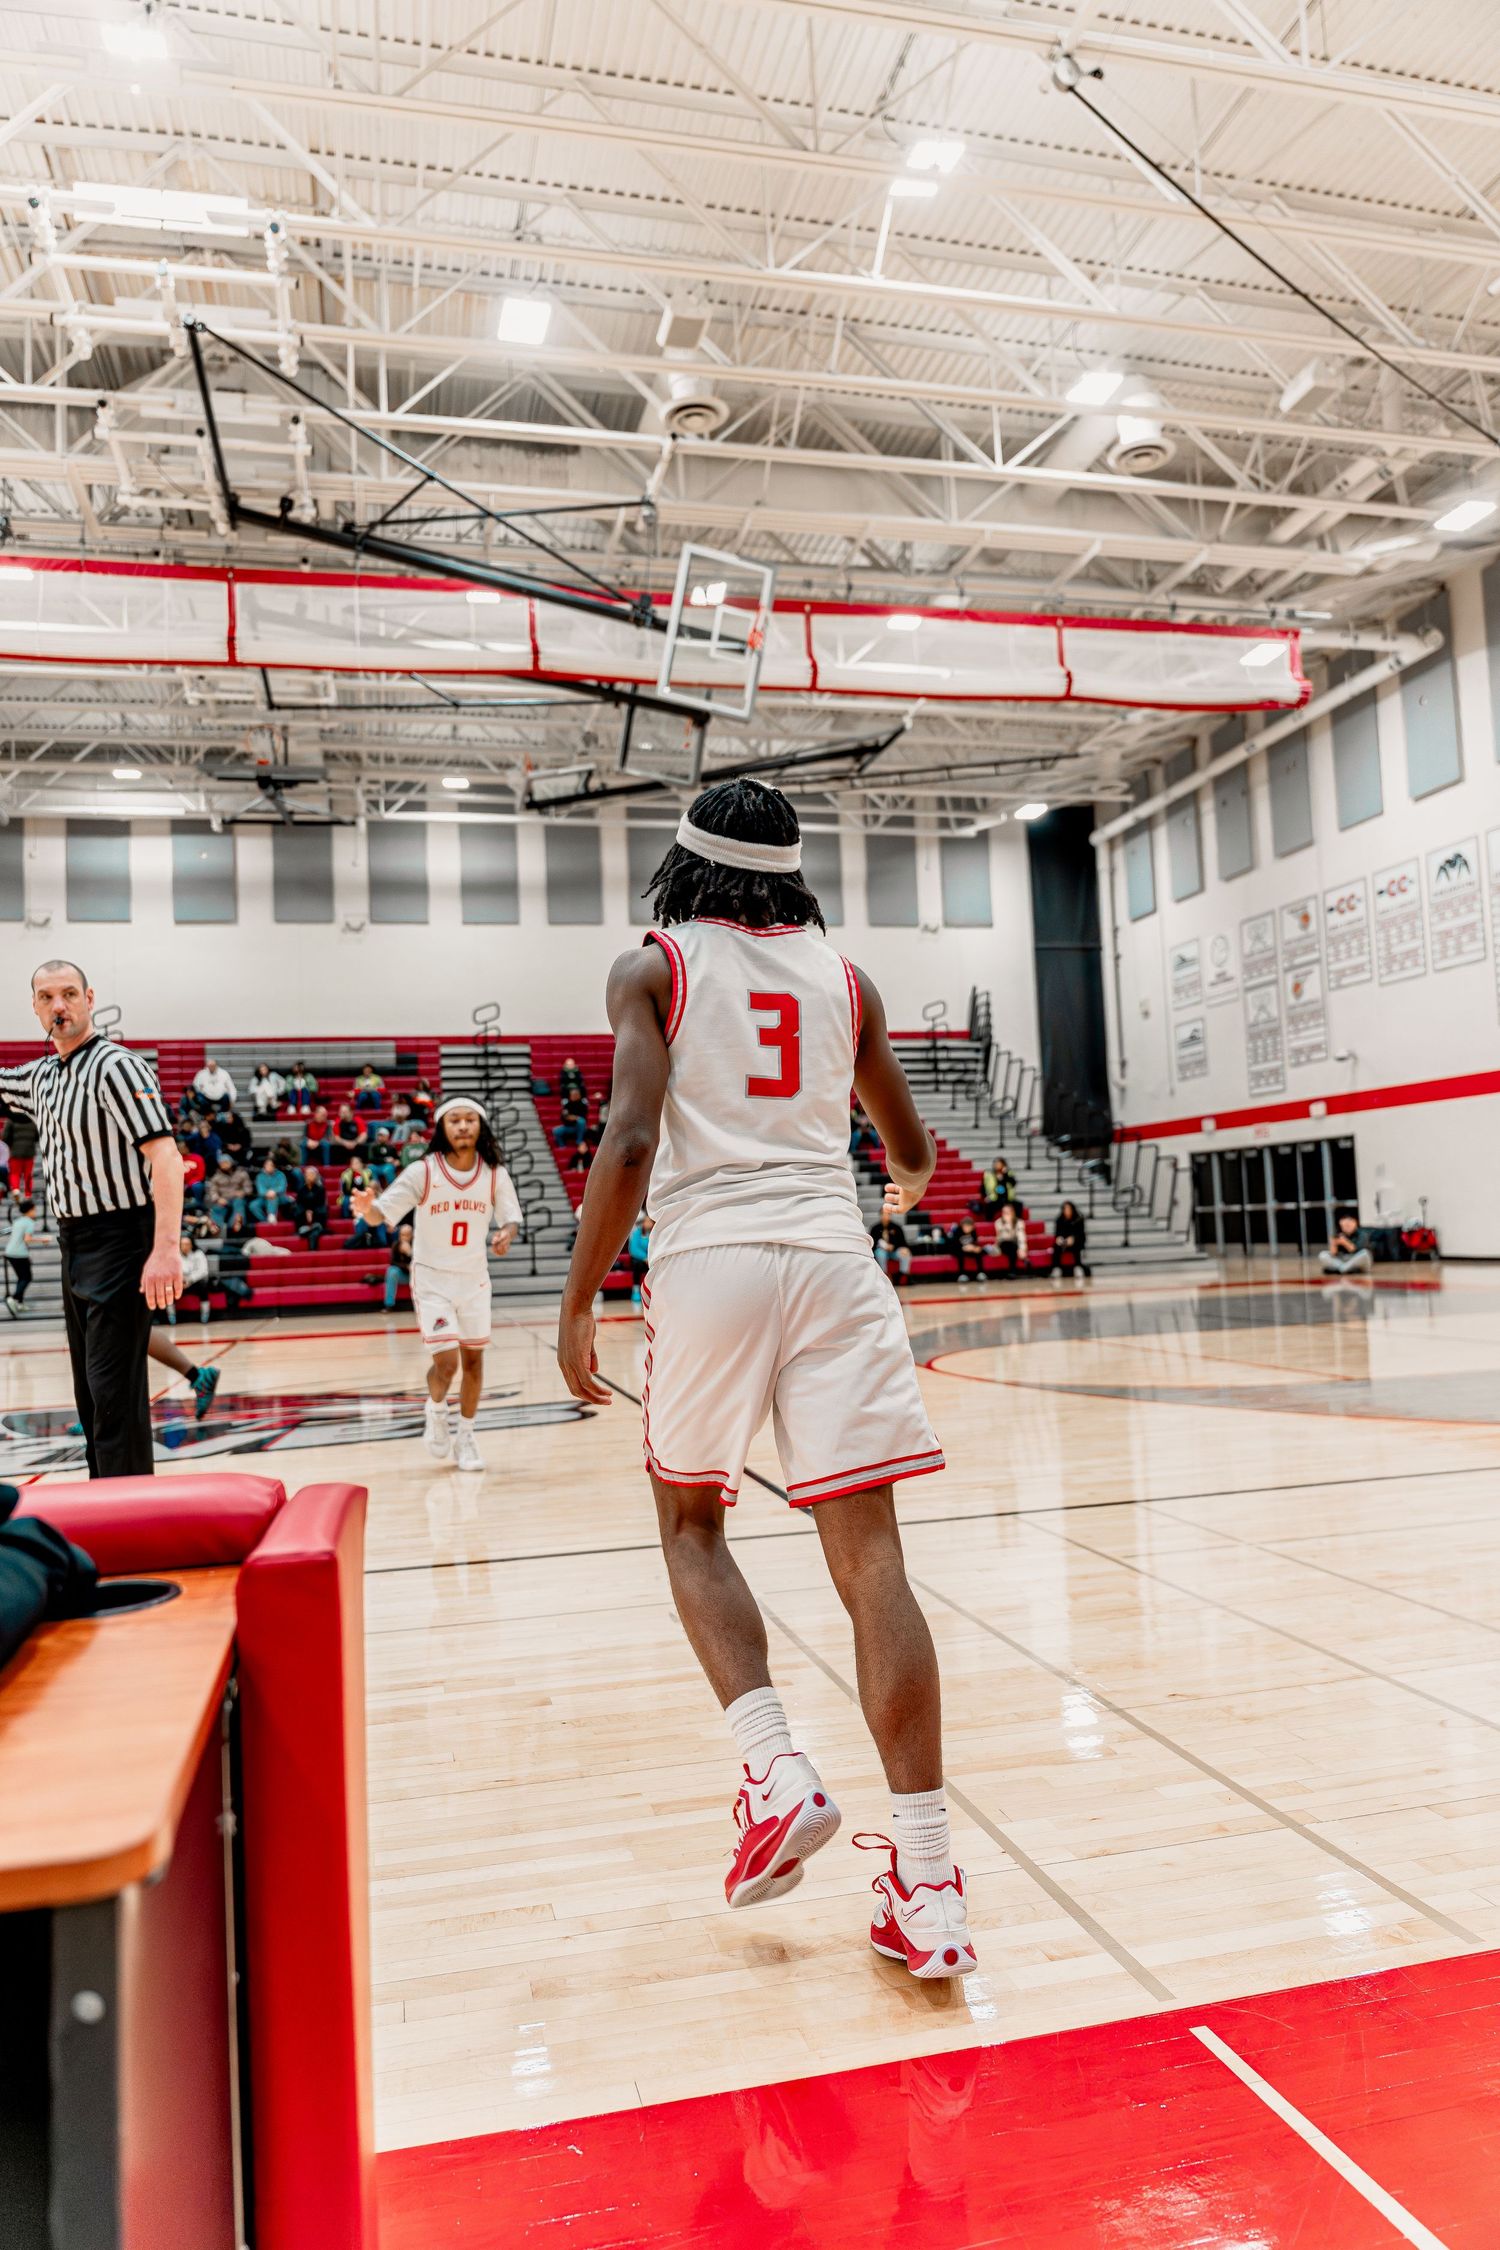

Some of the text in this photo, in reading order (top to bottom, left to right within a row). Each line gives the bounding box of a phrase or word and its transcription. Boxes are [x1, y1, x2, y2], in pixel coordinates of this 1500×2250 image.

[745, 989, 803, 1100] 3
[431, 1200, 486, 1215] RED WOLVES
[452, 1222, 468, 1246] 0
